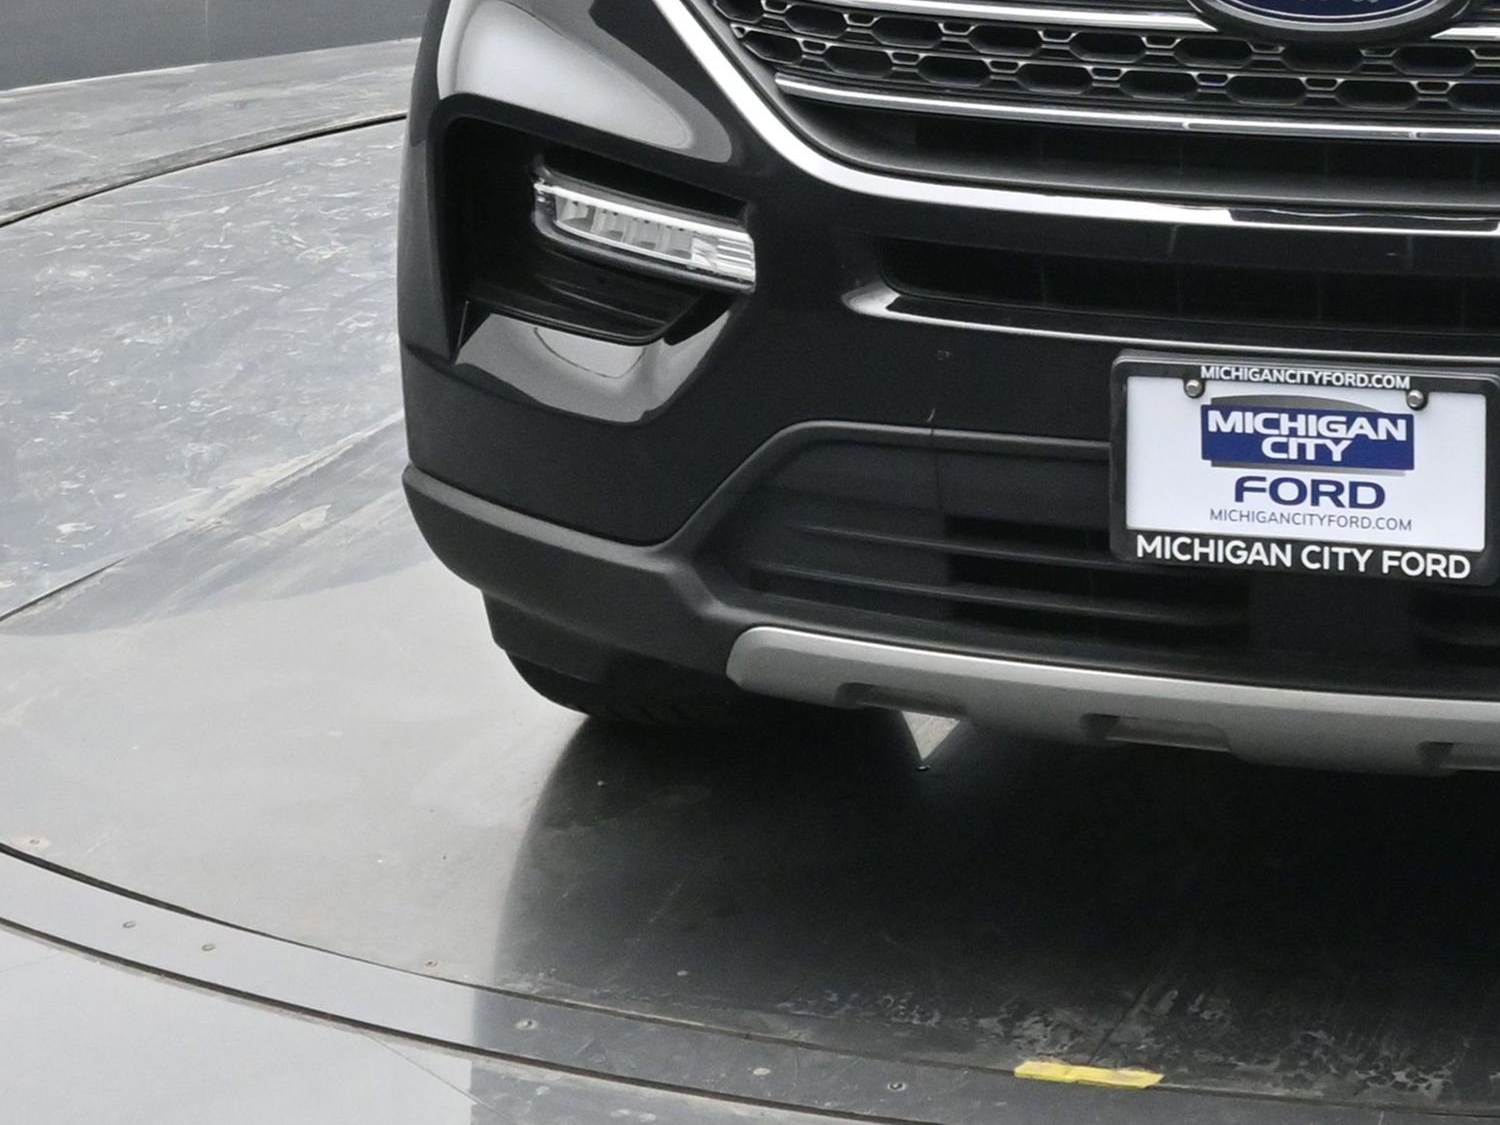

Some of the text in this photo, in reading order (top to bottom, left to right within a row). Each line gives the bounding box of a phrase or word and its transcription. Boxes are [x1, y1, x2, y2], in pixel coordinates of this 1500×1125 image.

[1200, 365, 1410, 390] MICHIGANCITYFORD.COM
[1207, 410, 1407, 441] MICHIGAN
[1261, 436, 1352, 462] CITY
[1234, 475, 1386, 509] FORD
[1209, 508, 1412, 532] MICHIGANCITYFORD.COM
[1136, 534, 1471, 579] MICHIGAN CITY FORD
